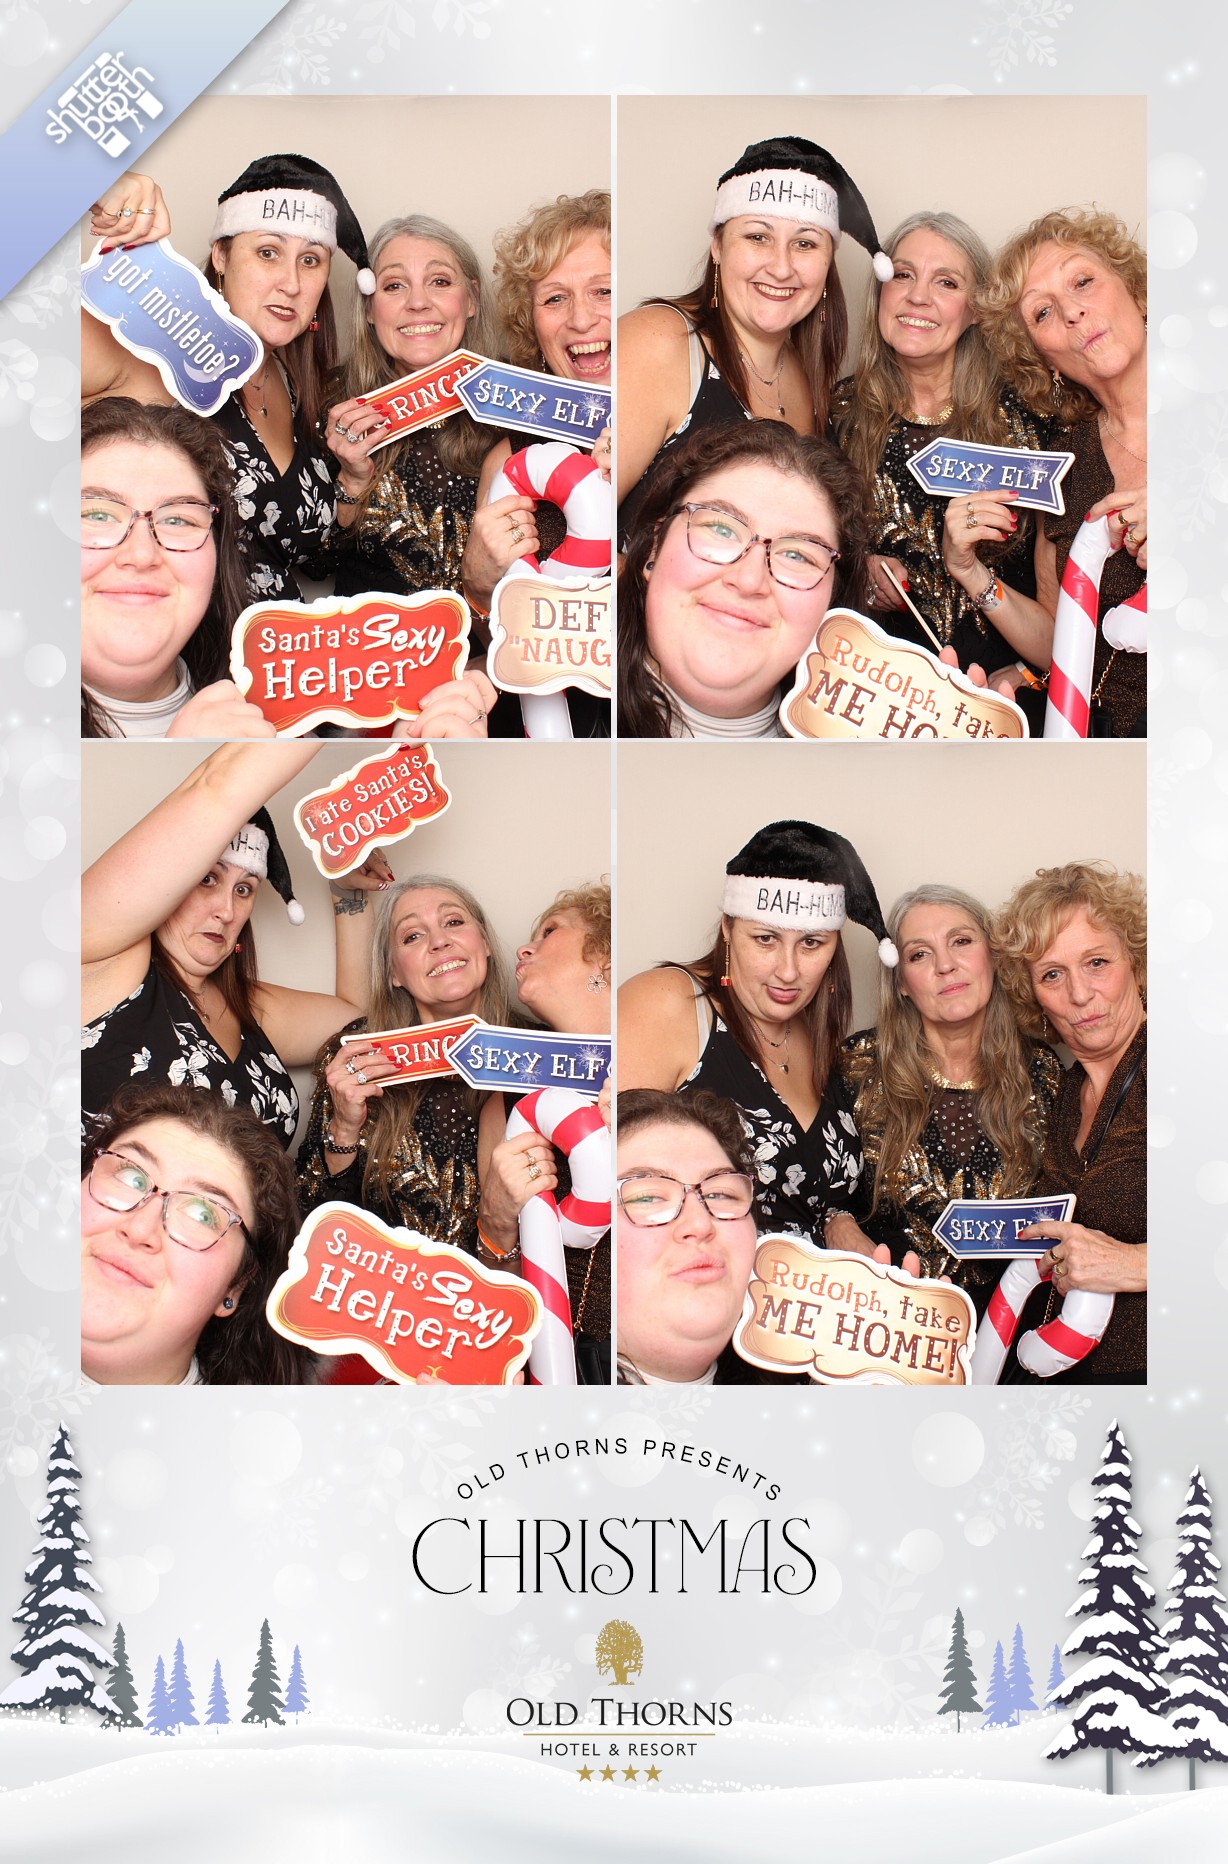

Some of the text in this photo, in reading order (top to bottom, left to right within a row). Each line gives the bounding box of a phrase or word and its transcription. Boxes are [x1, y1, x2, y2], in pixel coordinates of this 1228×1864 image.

[103, 254, 240, 382] got mistletoe?
[373, 363, 472, 429] RINC
[474, 378, 606, 429] SEXY ELF
[926, 454, 1049, 491] SEXY ELF
[257, 613, 446, 666] Santa's Sexy
[509, 635, 611, 667] "NAUG
[262, 655, 417, 703] Helper
[807, 669, 876, 727] ME
[829, 634, 941, 721] Rudolph,
[304, 755, 423, 833] I ate Santa's
[322, 772, 437, 857] COOKIES!
[467, 1044, 604, 1081] SEXY ELF
[949, 1218, 1006, 1242] SEXY
[310, 1262, 472, 1359] Helper
[326, 1228, 513, 1350] Santa's Sexy
[769, 1258, 961, 1333] Rudolph, take
[756, 1294, 958, 1378] ME HOME!
